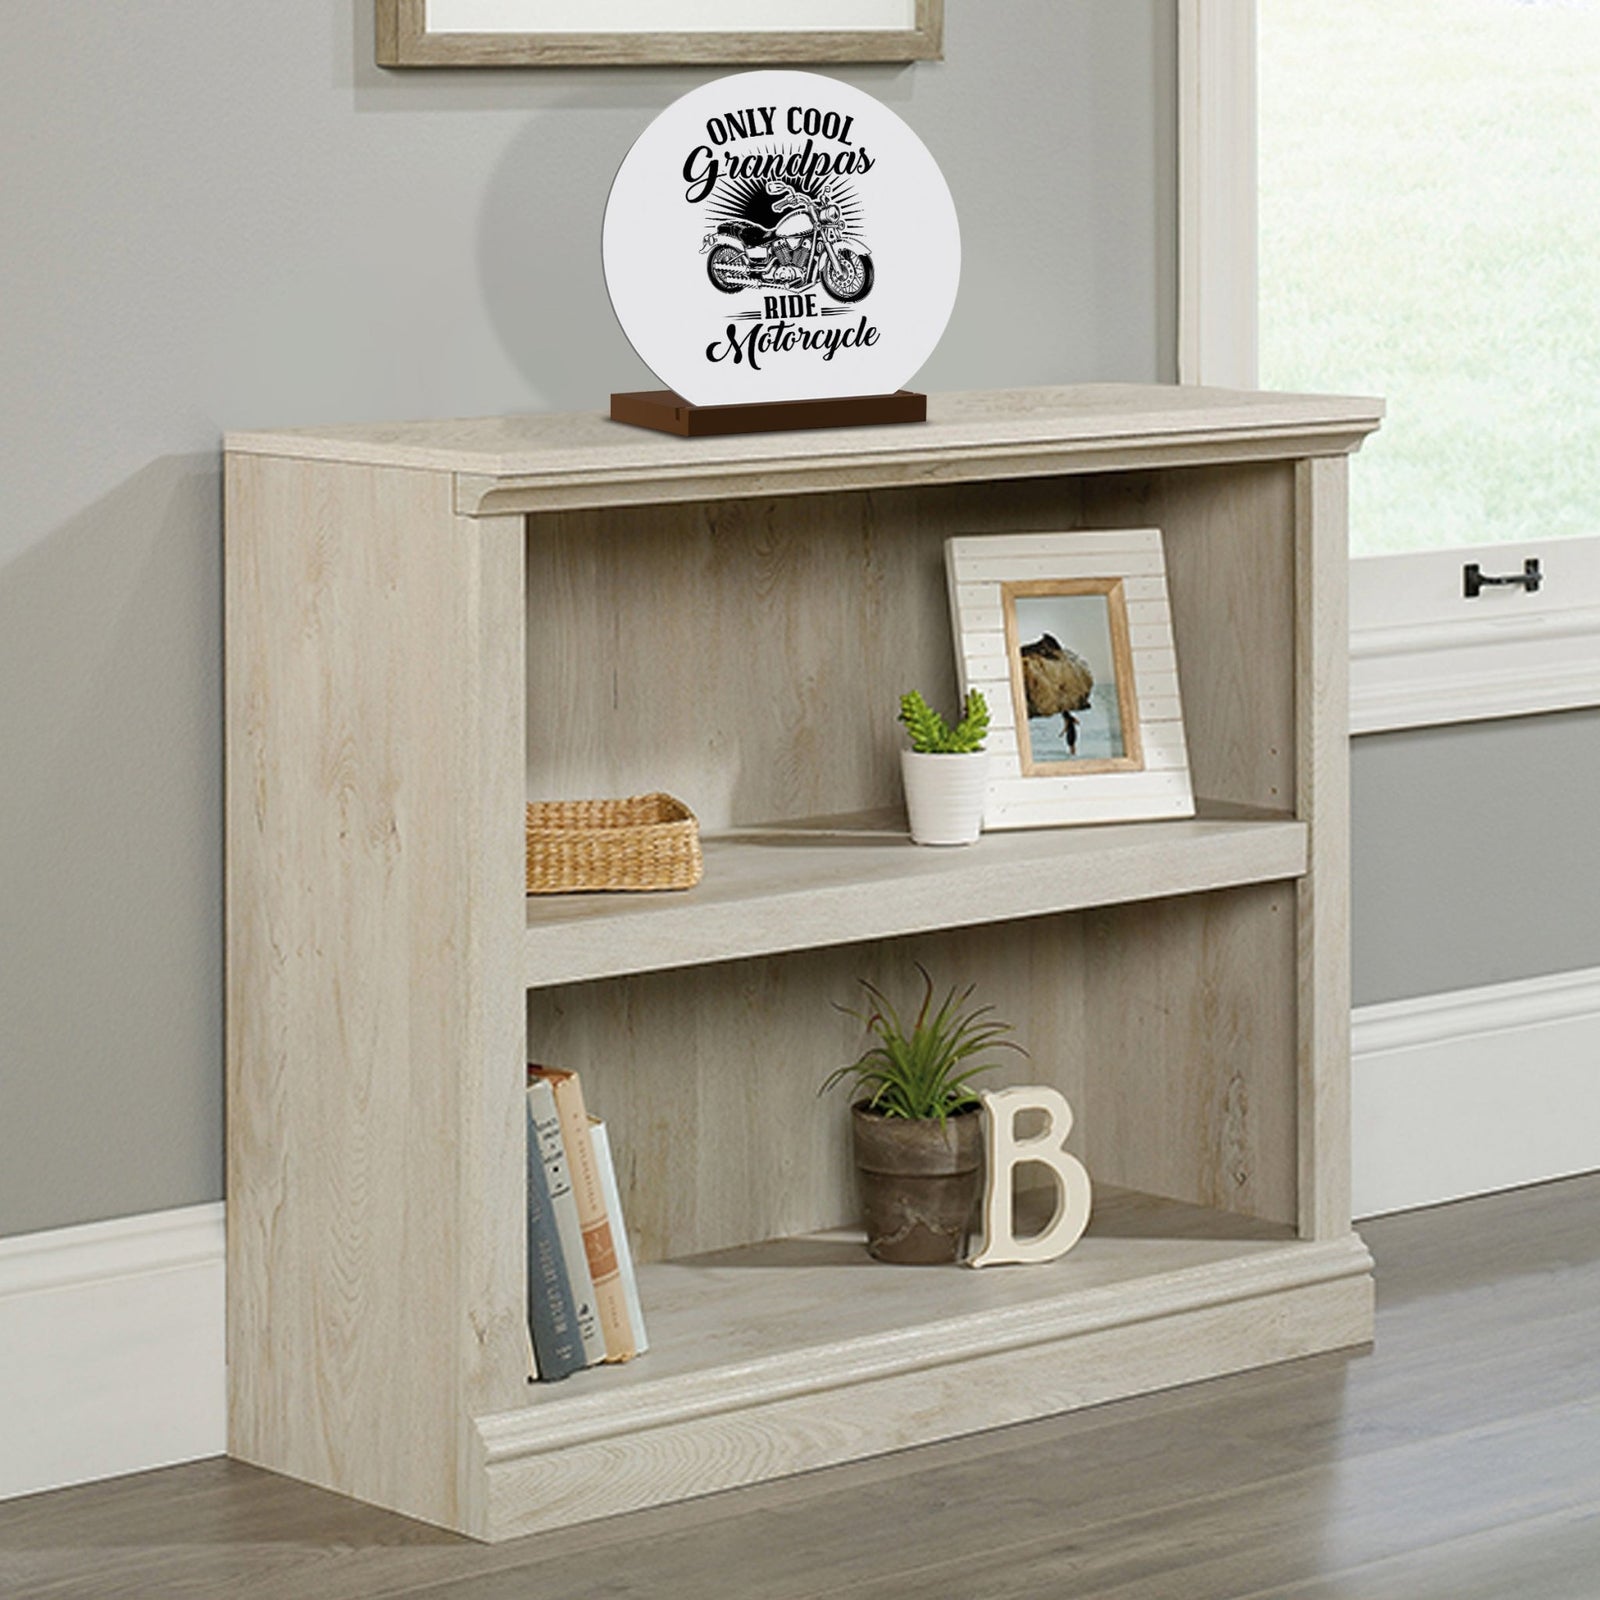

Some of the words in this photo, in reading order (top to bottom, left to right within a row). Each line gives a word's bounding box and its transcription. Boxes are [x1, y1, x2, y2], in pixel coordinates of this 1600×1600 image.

[706, 106, 776, 145] ONLY
[787, 106, 854, 146] COOL
[683, 139, 875, 203] Grandpas
[763, 293, 818, 319] RIDE
[705, 315, 880, 370] Motorcycle
[967, 1085, 1092, 1268] B
